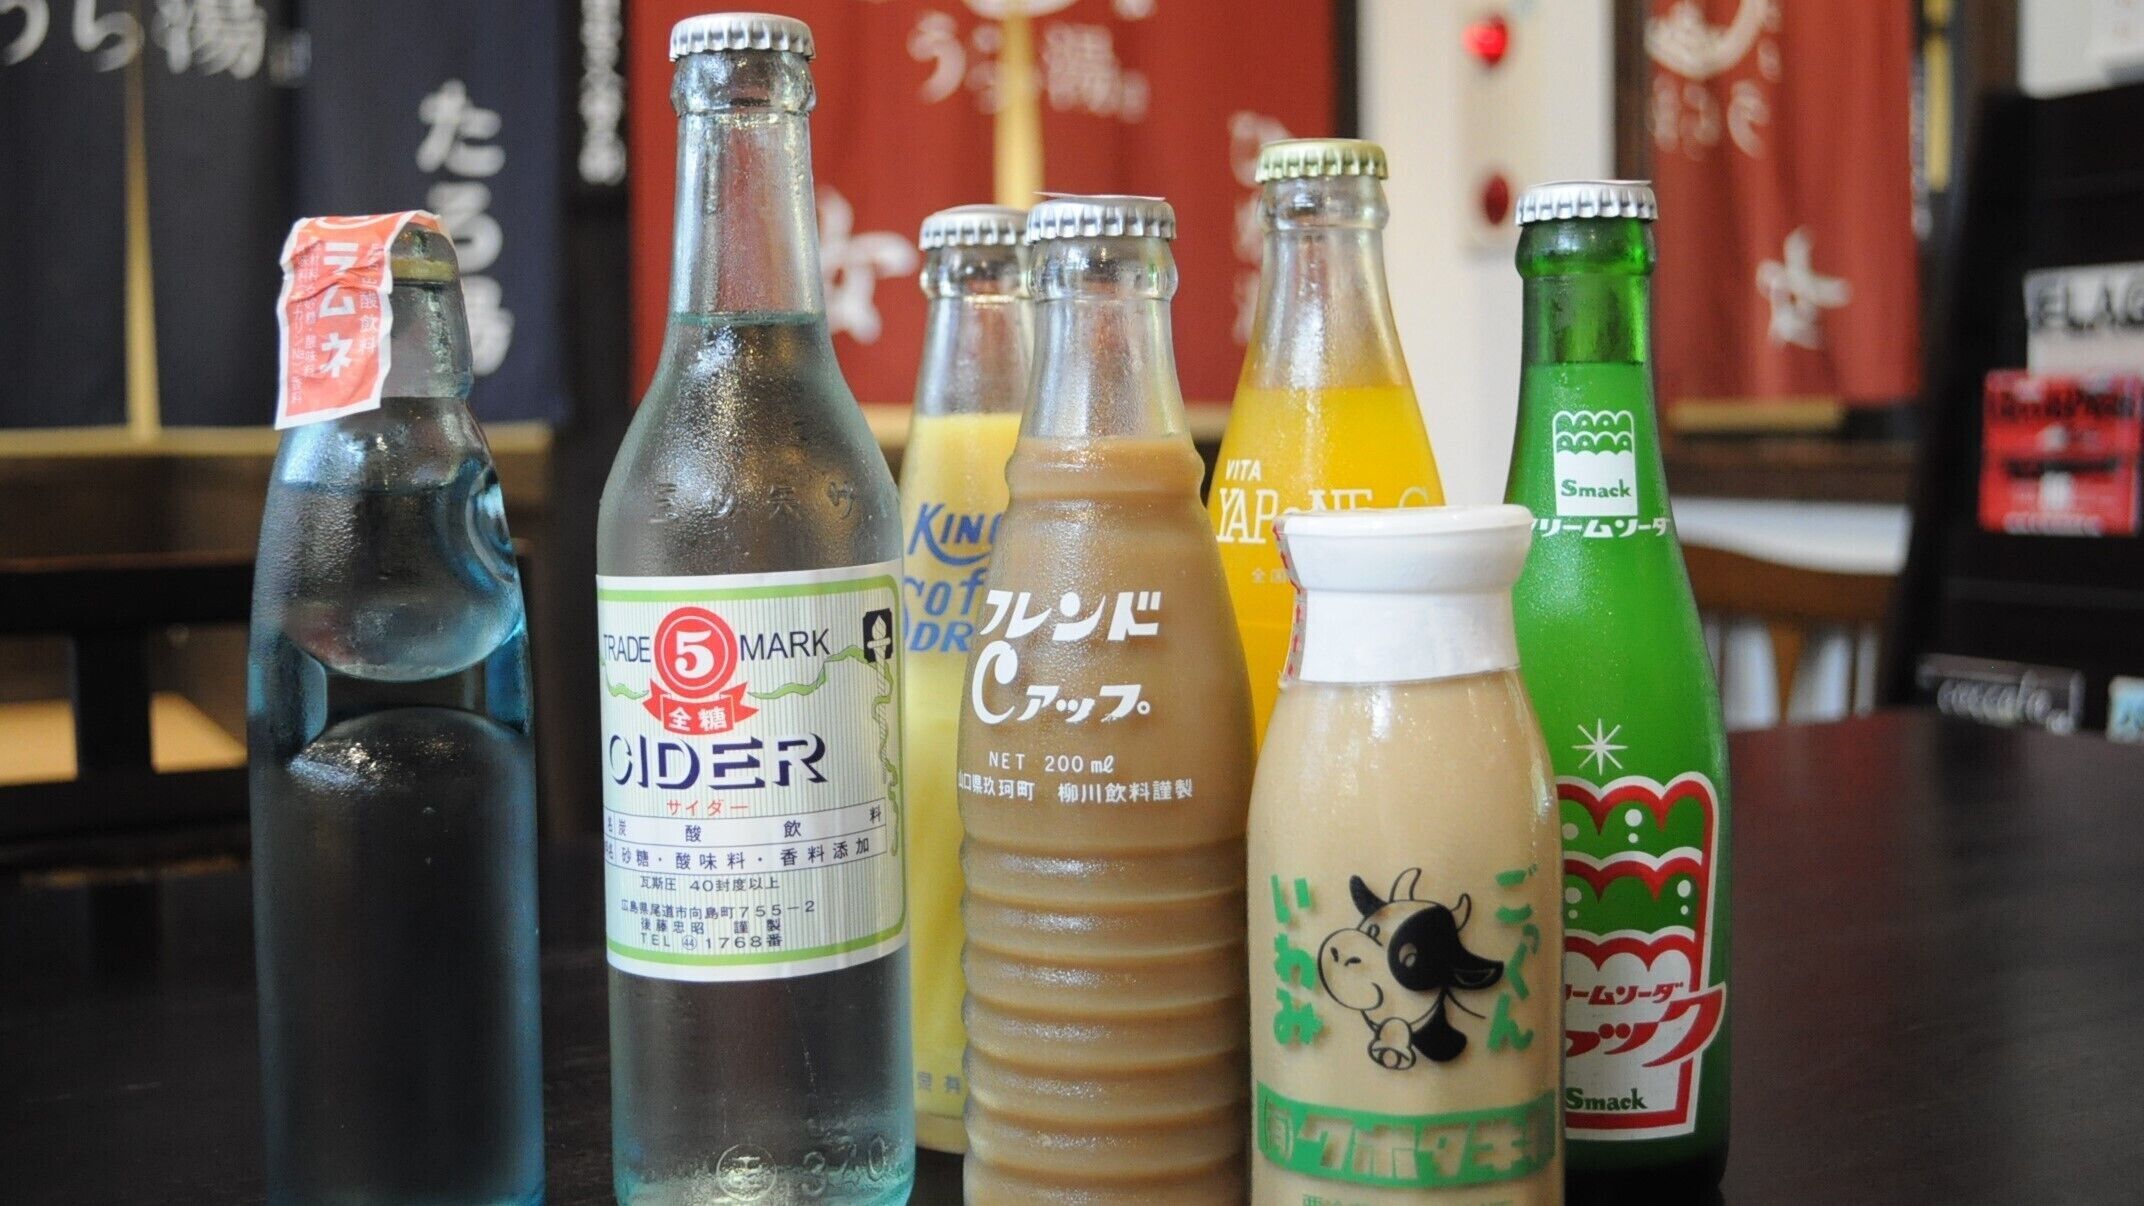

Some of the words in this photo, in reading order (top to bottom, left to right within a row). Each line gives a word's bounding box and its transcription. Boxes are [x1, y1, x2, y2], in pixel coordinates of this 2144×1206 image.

[319, 242, 358, 378] ラムネ
[1225, 459, 1262, 481] VITA
[1561, 478, 1632, 498] Smack
[980, 589, 1162, 642] フレンド
[603, 633, 650, 662] TRADE
[740, 628, 830, 661] MARK
[674, 629, 715, 679] 5
[668, 706, 728, 731] 全糖
[609, 732, 829, 790] CIDER
[989, 751, 1026, 770] NET
[1045, 755, 1084, 773] 200
[1057, 778, 1194, 804] 柳川飲料謹製
[666, 799, 749, 816] サイダー
[689, 877, 780, 892] 40封度以上
[641, 932, 670, 948] TEL
[1271, 873, 1324, 1045] いわみ
[1486, 864, 1541, 1055] ごっくん
[1565, 1086, 1648, 1112] Smack
